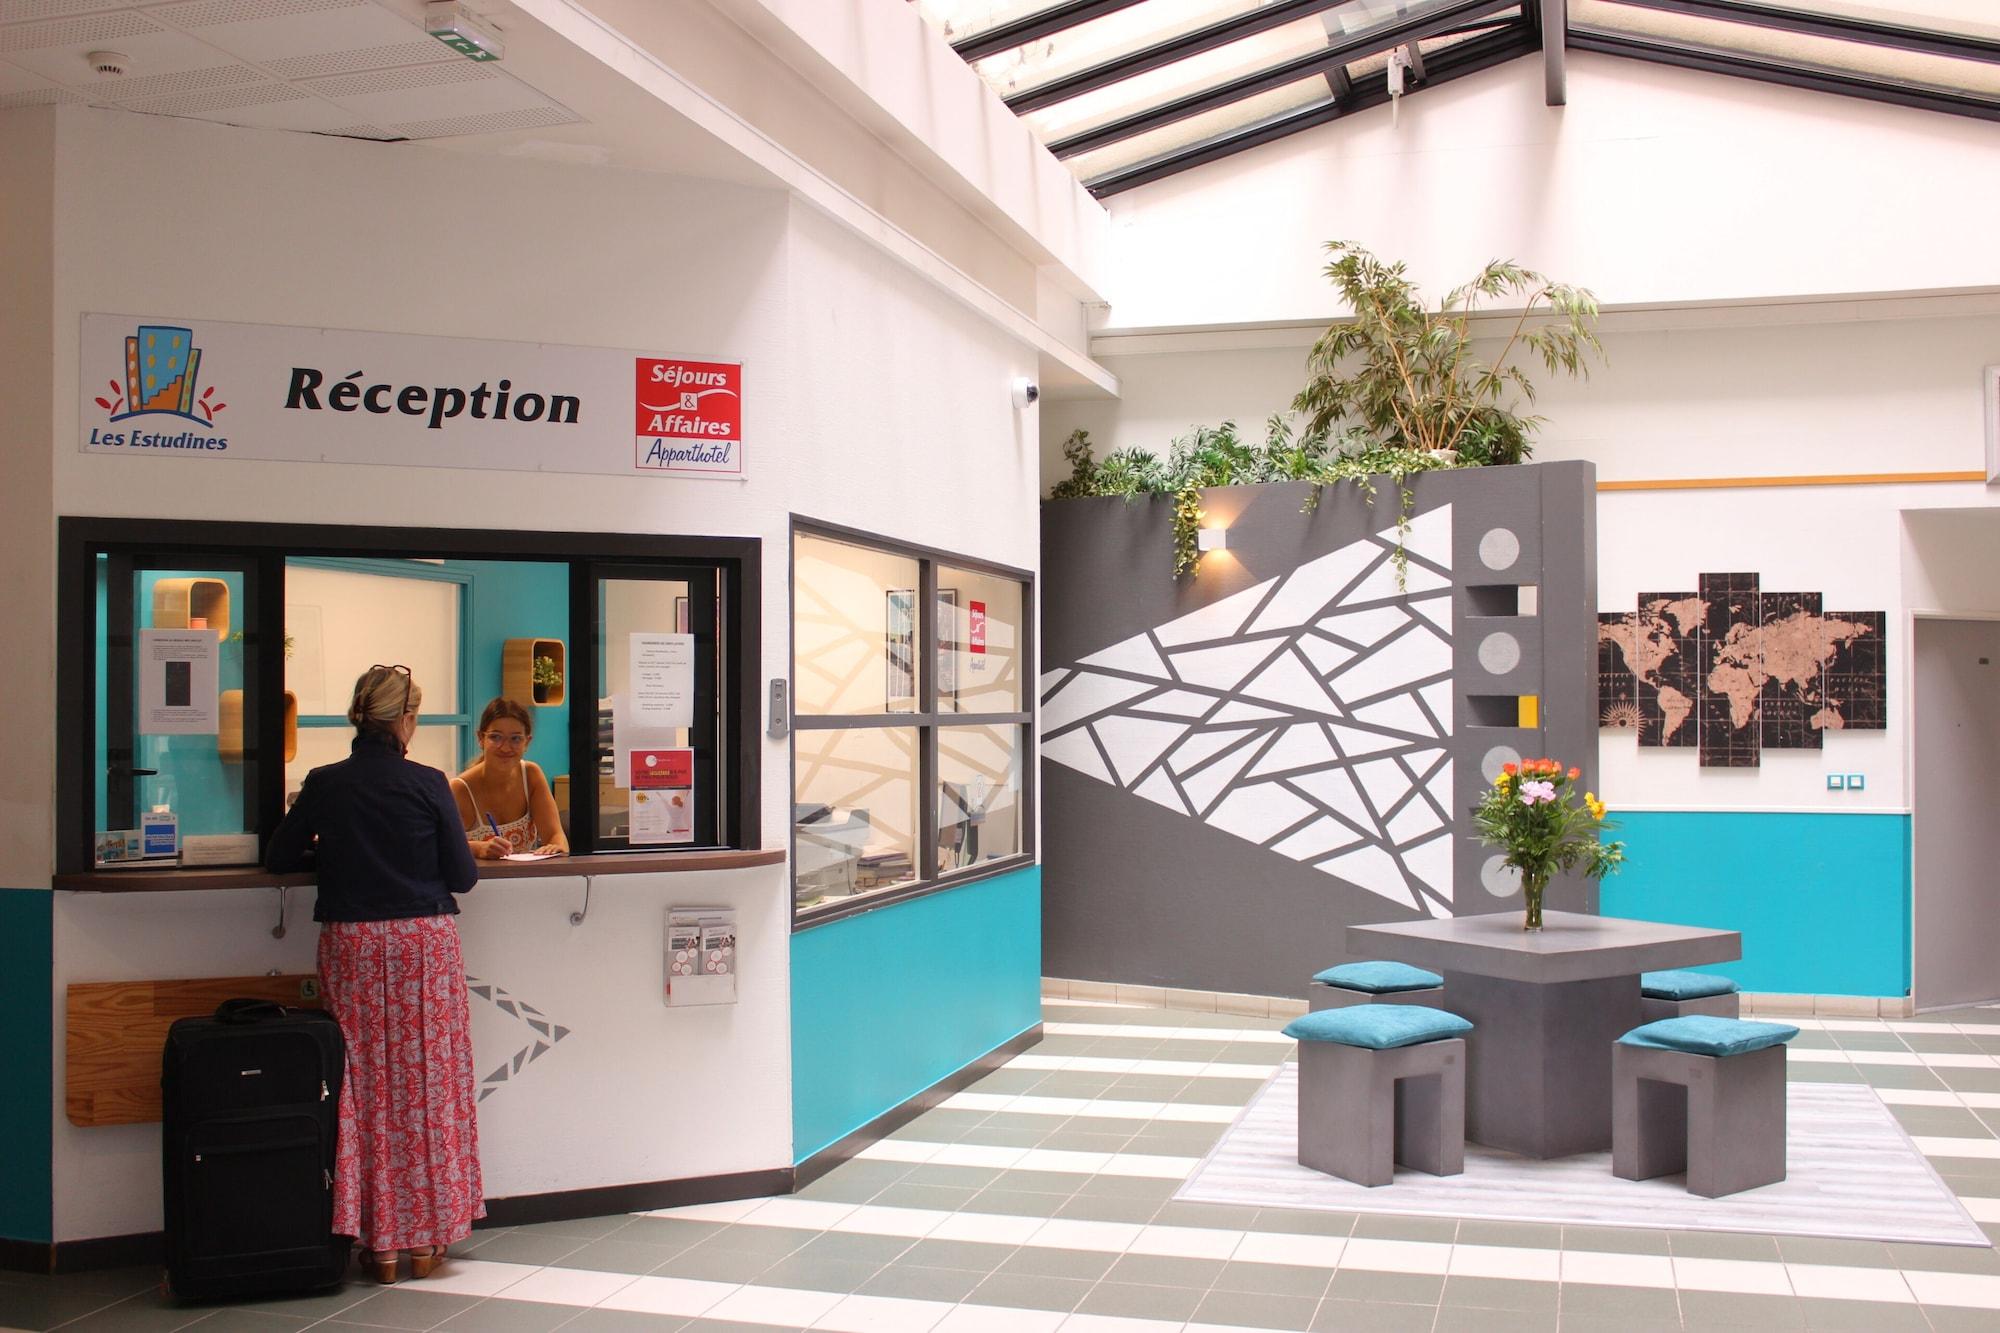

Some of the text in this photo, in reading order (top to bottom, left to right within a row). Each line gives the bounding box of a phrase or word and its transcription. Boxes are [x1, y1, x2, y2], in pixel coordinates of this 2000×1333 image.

[650, 364, 727, 388] Séjours
[285, 367, 582, 430] Réception
[684, 394, 696, 409] &
[647, 413, 731, 436] Affaires
[89, 428, 228, 451] Les Estudines
[645, 437, 732, 467] Apparthotel
